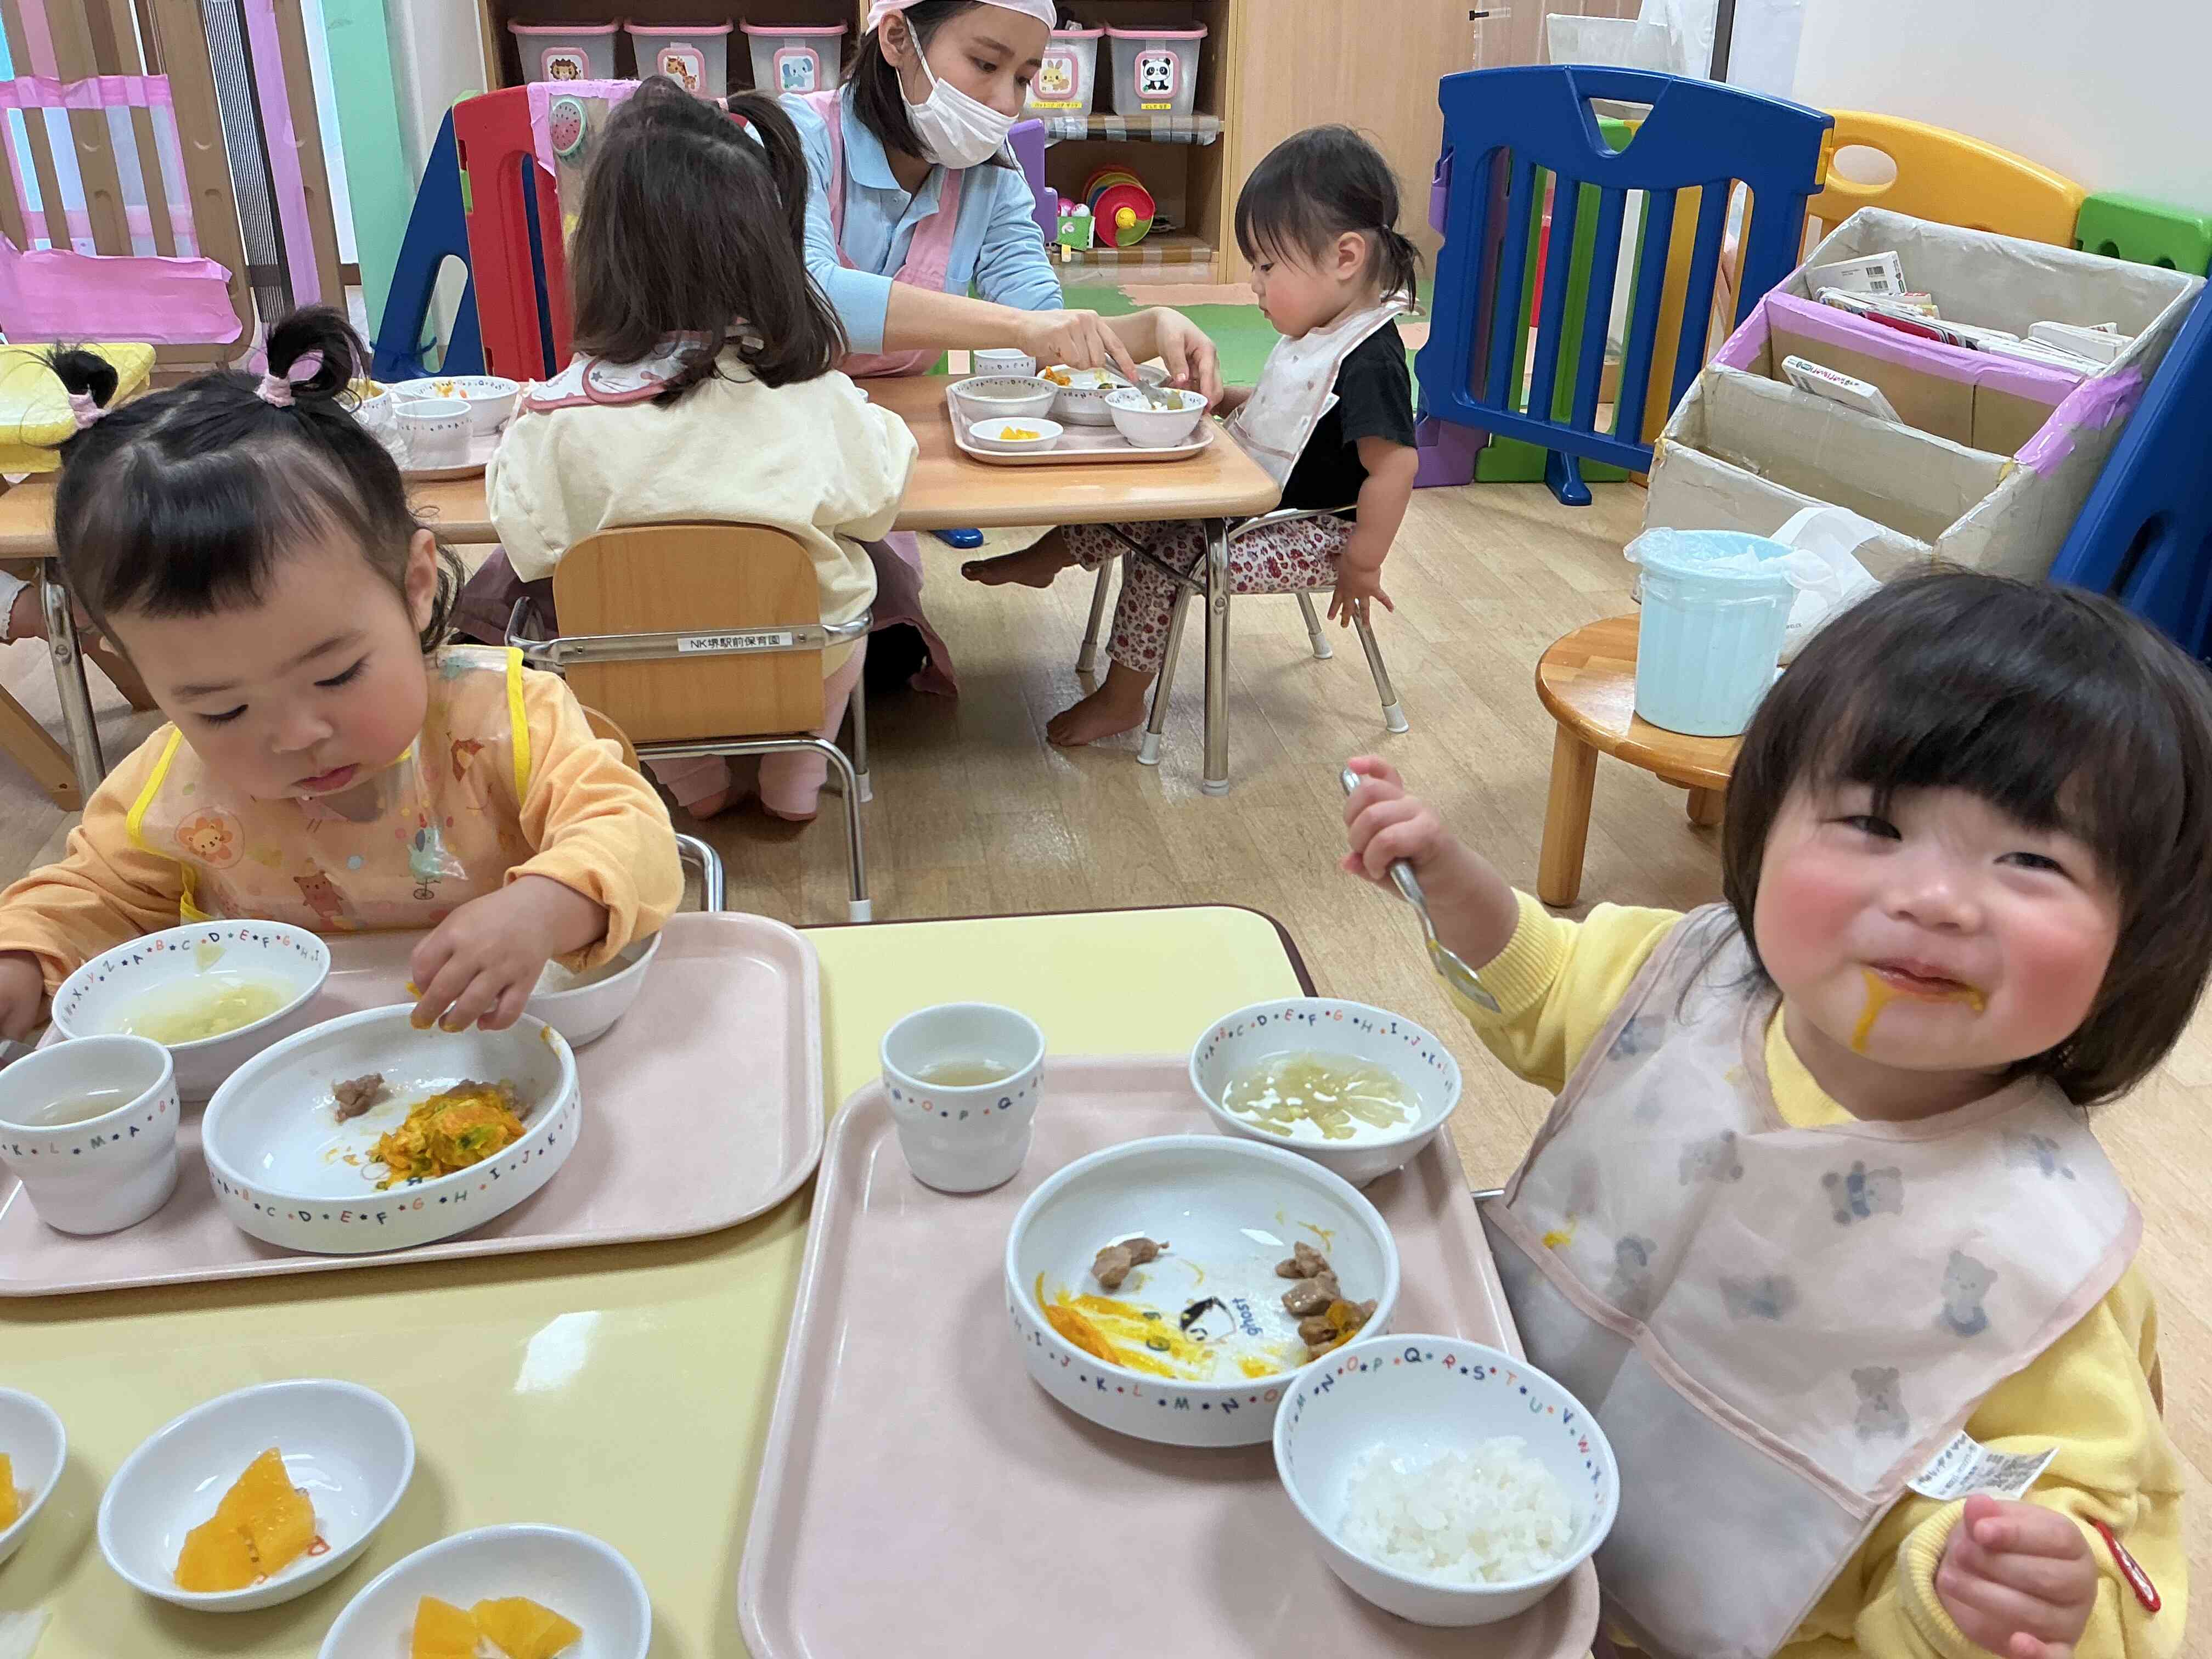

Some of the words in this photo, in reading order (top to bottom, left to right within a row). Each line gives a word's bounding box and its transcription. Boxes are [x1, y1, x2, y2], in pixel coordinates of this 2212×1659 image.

[72, 989, 82, 1000] X
[103, 961, 115, 972] Z
[133, 955, 144, 965] A
[156, 940, 164, 950] B
[182, 940, 190, 950] C
[208, 933, 220, 942] D
[240, 929, 250, 941] E
[263, 937, 269, 948] F
[283, 935, 290, 946] G
[1237, 1025, 1244, 1036] C
[1257, 1014, 1267, 1026] D
[1285, 1008, 1294, 1021] E
[1308, 1014, 1316, 1026] F
[1361, 1020, 1373, 1033] H
[1391, 1022, 1397, 1034] I
[922, 1100, 933, 1111] O
[997, 1097, 1013, 1110] Q
[12, 1144, 22, 1155] K
[90, 1135, 106, 1149] M
[129, 1126, 140, 1137] A
[267, 1207, 275, 1217] C
[298, 1211, 312, 1222] D
[340, 1210, 353, 1223] E
[376, 1211, 388, 1225] F
[413, 1197, 424, 1210] G
[454, 1190, 467, 1203] H
[489, 1167, 500, 1180] I
[522, 1150, 529, 1164] J
[548, 1132, 555, 1146] K
[1232, 1297, 1263, 1336] ghost
[1096, 1376, 1108, 1392] K
[1133, 1384, 1143, 1396] L
[1174, 1397, 1189, 1410] M
[1221, 1398, 1239, 1414] N
[1322, 1373, 1334, 1392] N
[1347, 1356, 1358, 1371] O
[1373, 1357, 1383, 1372] P
[1404, 1347, 1423, 1363] Q
[1442, 1353, 1457, 1369] R
[1473, 1365, 1485, 1381] S
[1506, 1370, 1518, 1386] T
[1530, 1396, 1543, 1414] U
[1563, 1408, 1573, 1424] V
